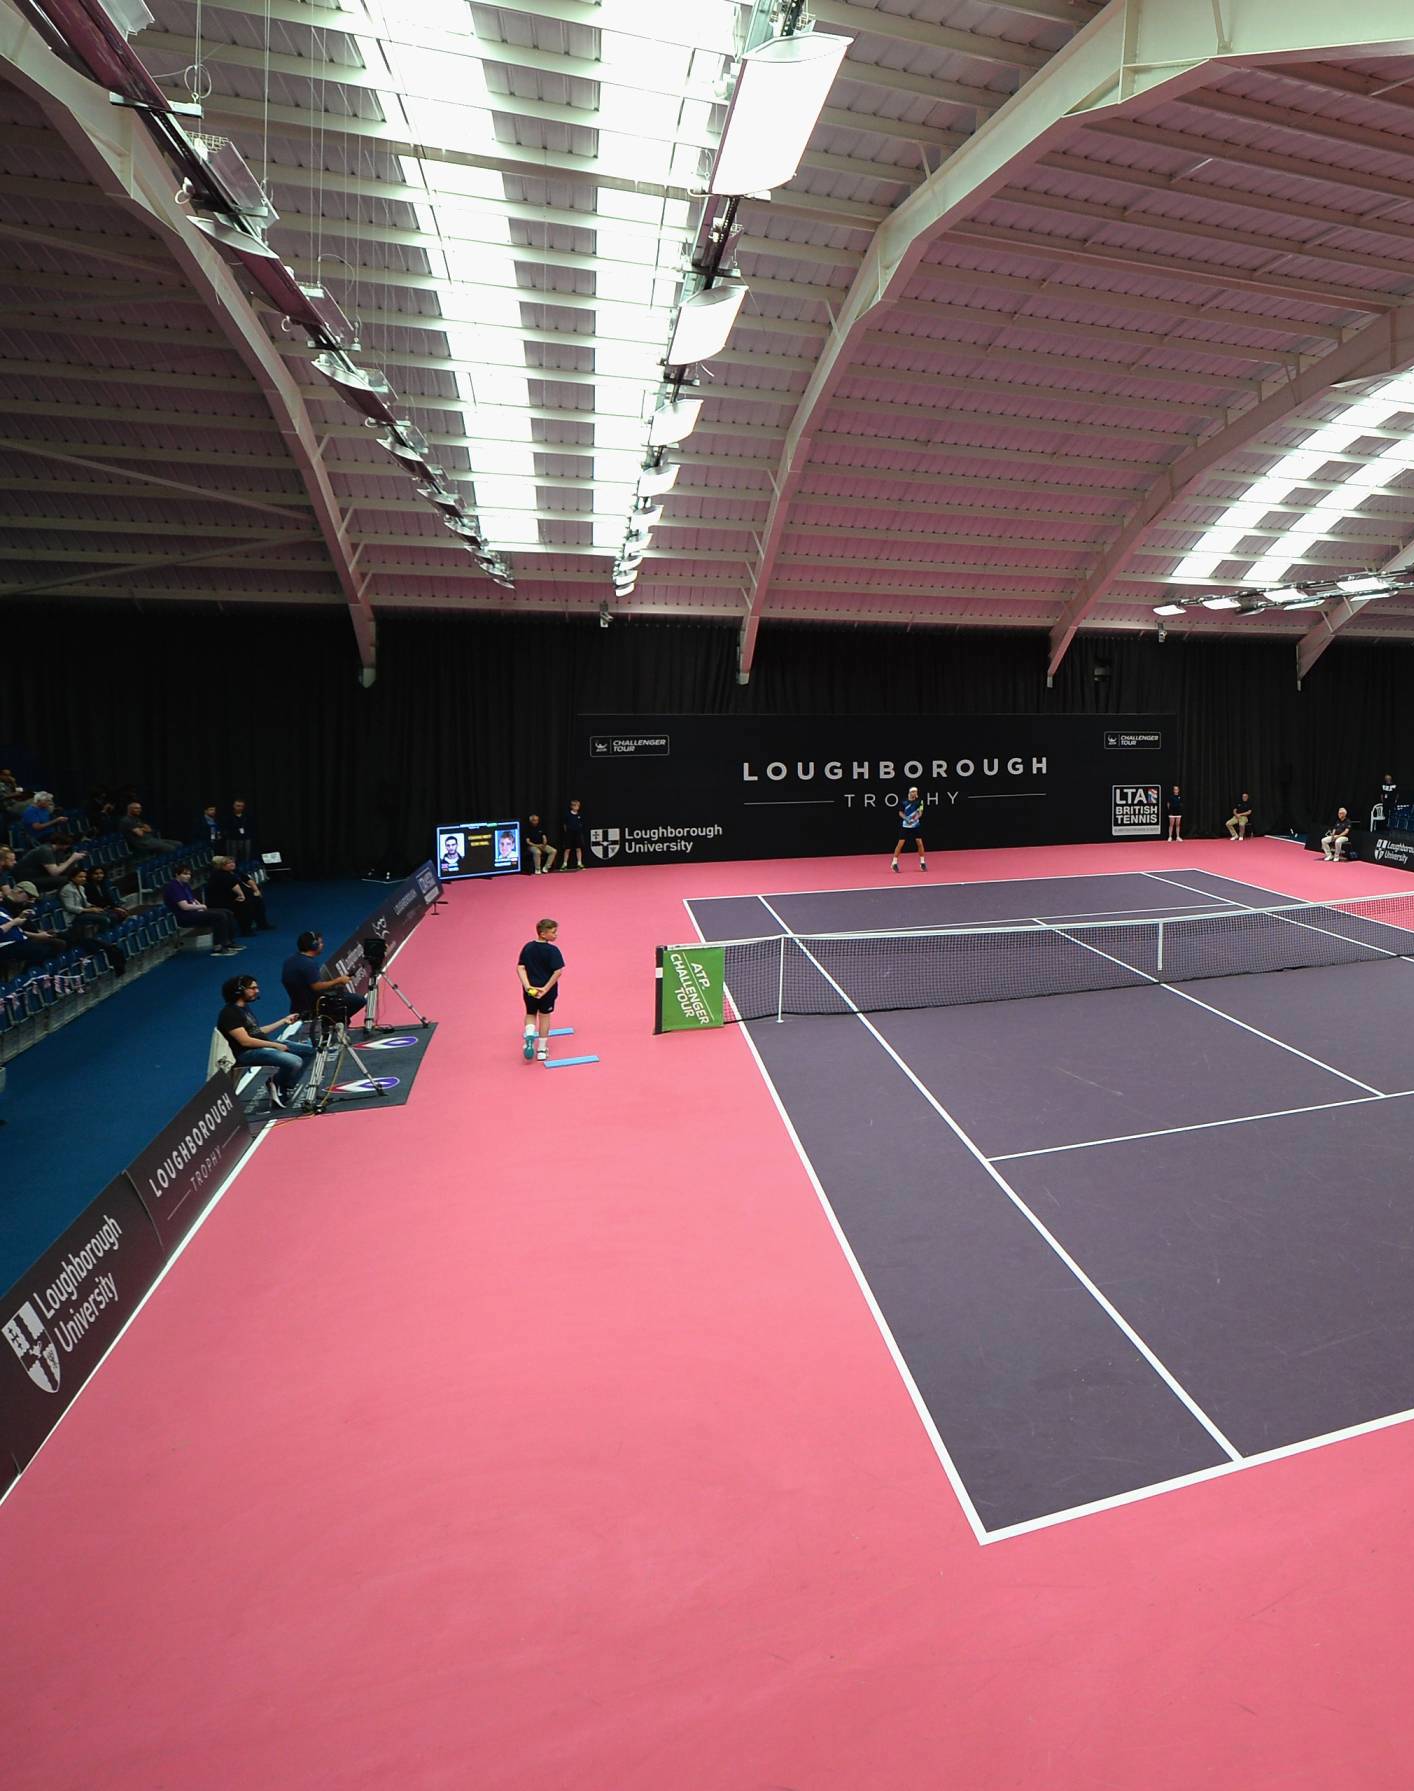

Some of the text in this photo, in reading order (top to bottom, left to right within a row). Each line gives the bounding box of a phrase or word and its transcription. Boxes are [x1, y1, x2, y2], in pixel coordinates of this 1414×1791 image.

[743, 757, 1047, 781] LOUGHBOROUGH
[844, 791, 959, 808] TROHY
[1115, 788, 1147, 804] LTA
[1115, 805, 1158, 815] BRITISH
[1116, 814, 1158, 824] TENNIS
[625, 824, 723, 841] Loughborough
[625, 839, 693, 854] University
[1384, 850, 1409, 865] University
[670, 953, 710, 1025] CHALLENGER
[674, 986, 695, 1018] TOUR
[149, 1093, 234, 1197] LOUGHBOROUGH
[190, 1147, 223, 1193] TROPHY
[33, 1215, 122, 1320] Loughborough
[54, 1273, 119, 1353] University
